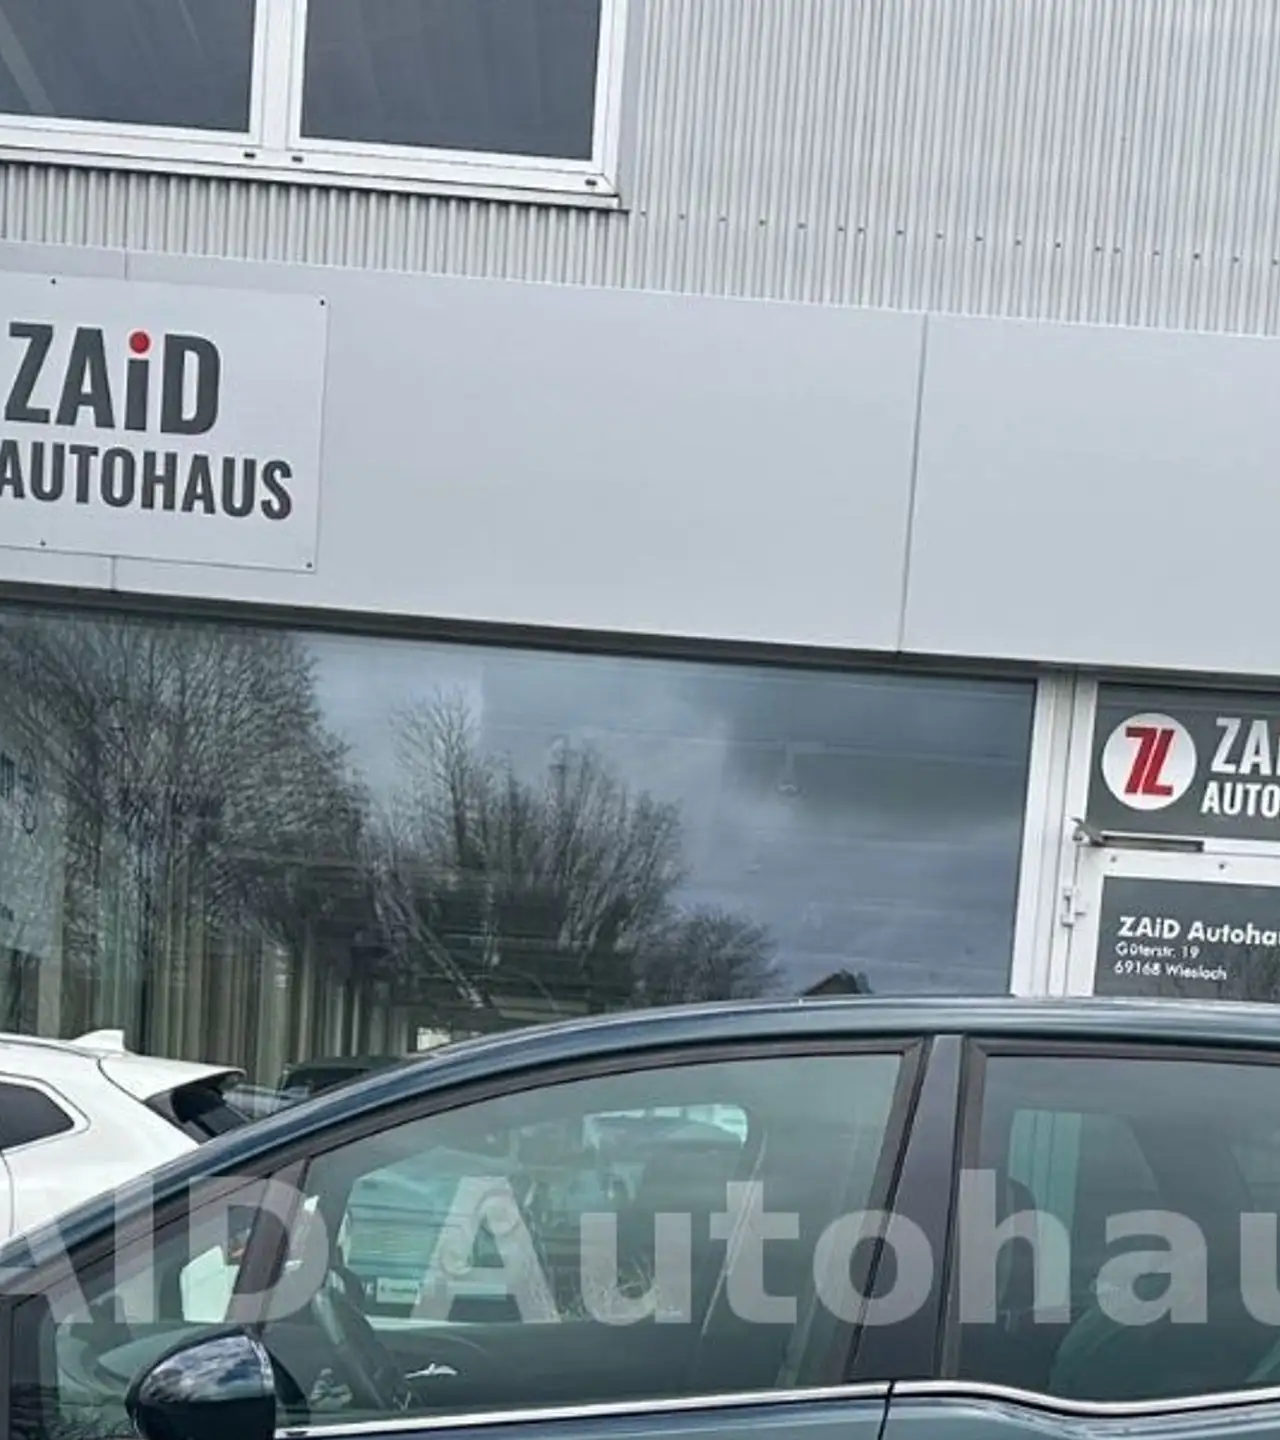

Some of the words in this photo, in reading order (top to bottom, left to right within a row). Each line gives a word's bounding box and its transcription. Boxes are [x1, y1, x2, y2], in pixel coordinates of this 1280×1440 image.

[4, 322, 220, 436] ZAiD
[1118, 916, 1181, 939] ZAiD
[1116, 942, 1176, 959] Güterstr.
[1182, 946, 1200, 959] 19
[1115, 960, 1160, 976] 69168
[1166, 964, 1227, 981] Wiesloch
